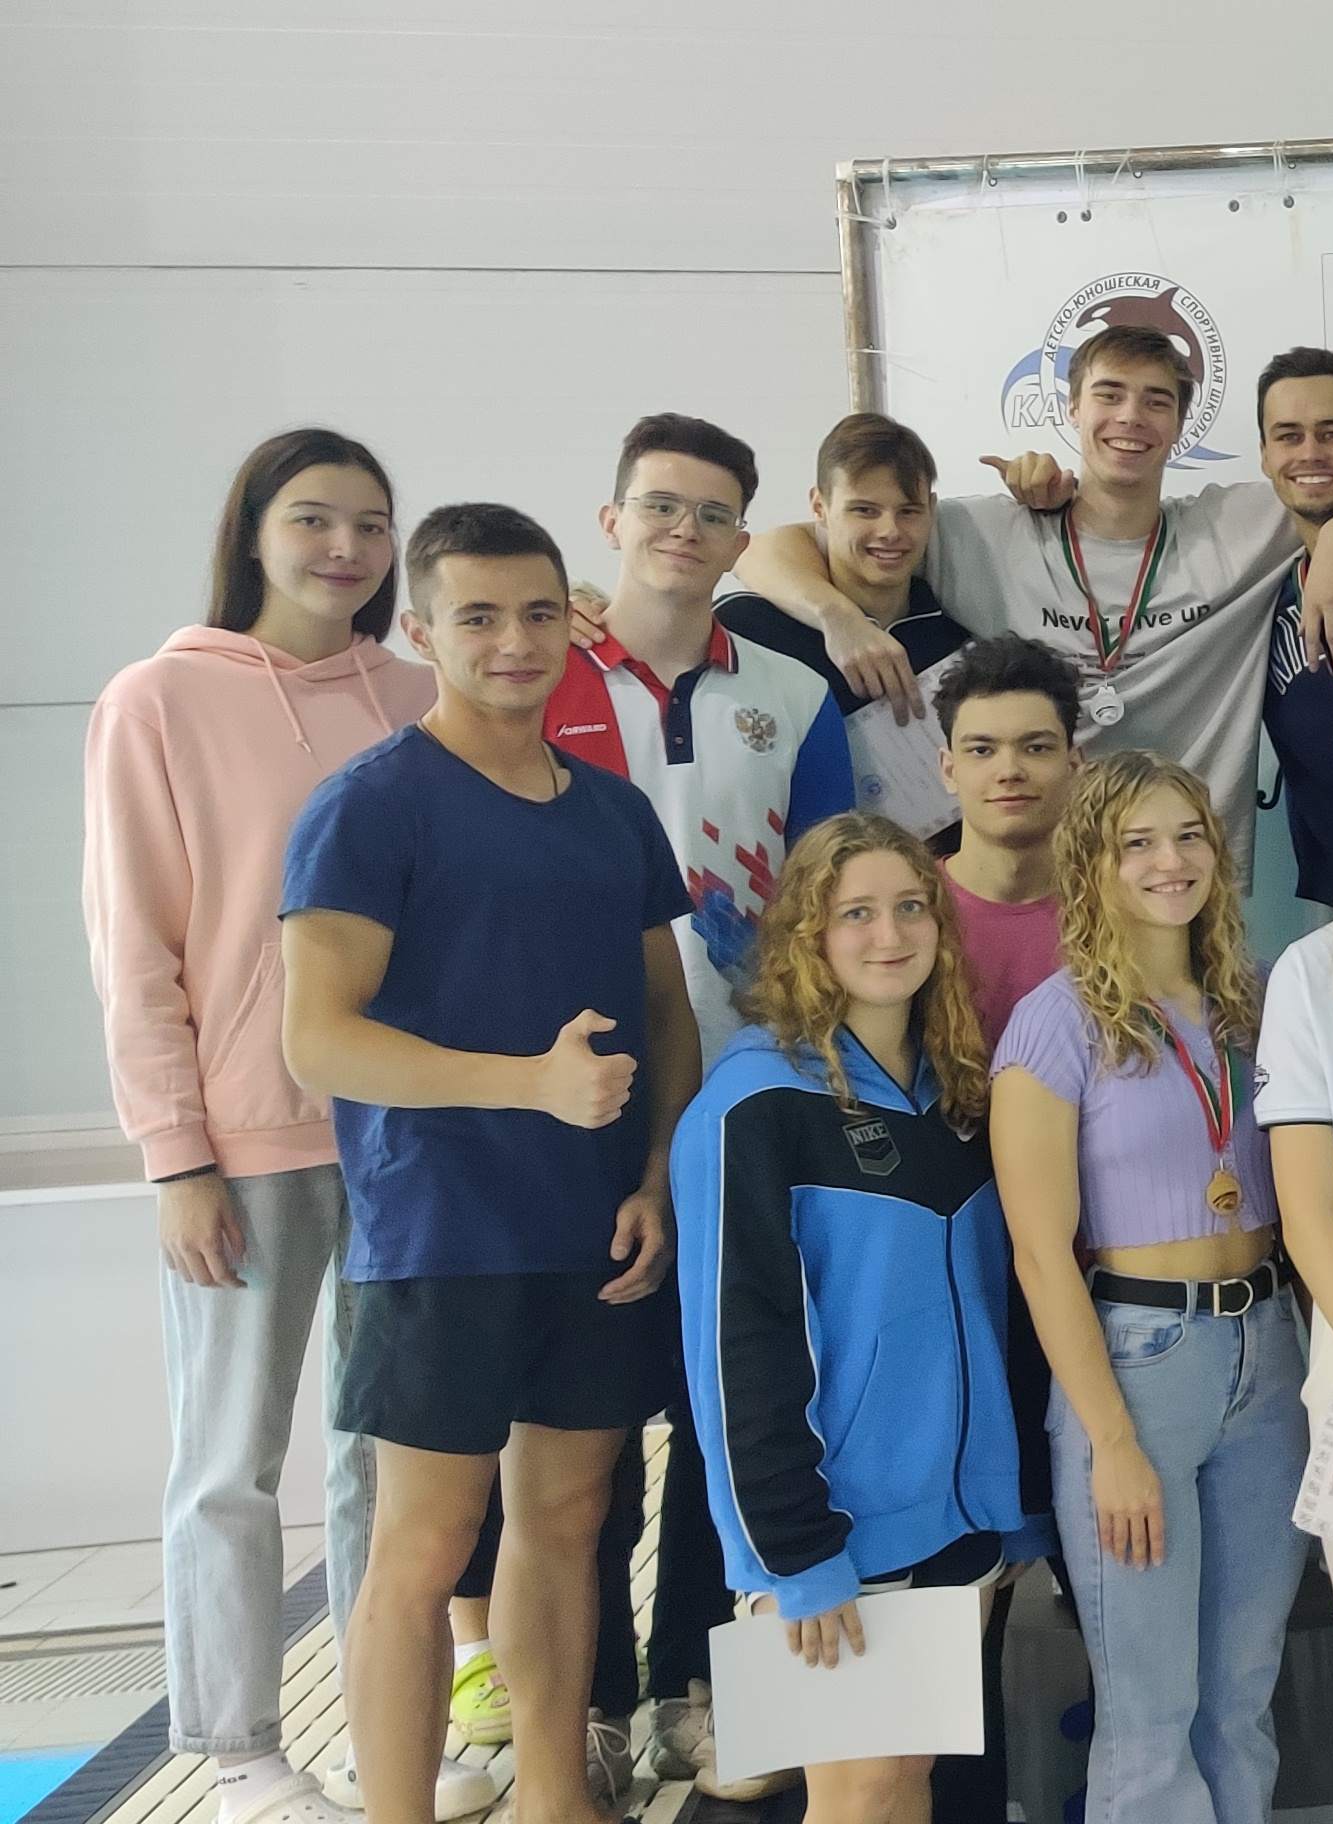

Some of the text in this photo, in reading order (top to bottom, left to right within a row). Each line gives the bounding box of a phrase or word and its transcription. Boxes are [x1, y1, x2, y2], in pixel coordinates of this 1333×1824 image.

[1044, 275, 1224, 440] ДЕТСКО-ЮНОШЕСКАЯ СПОРТИВНАЯ ШКОЛА
[847, 1122, 890, 1146] NIKE
